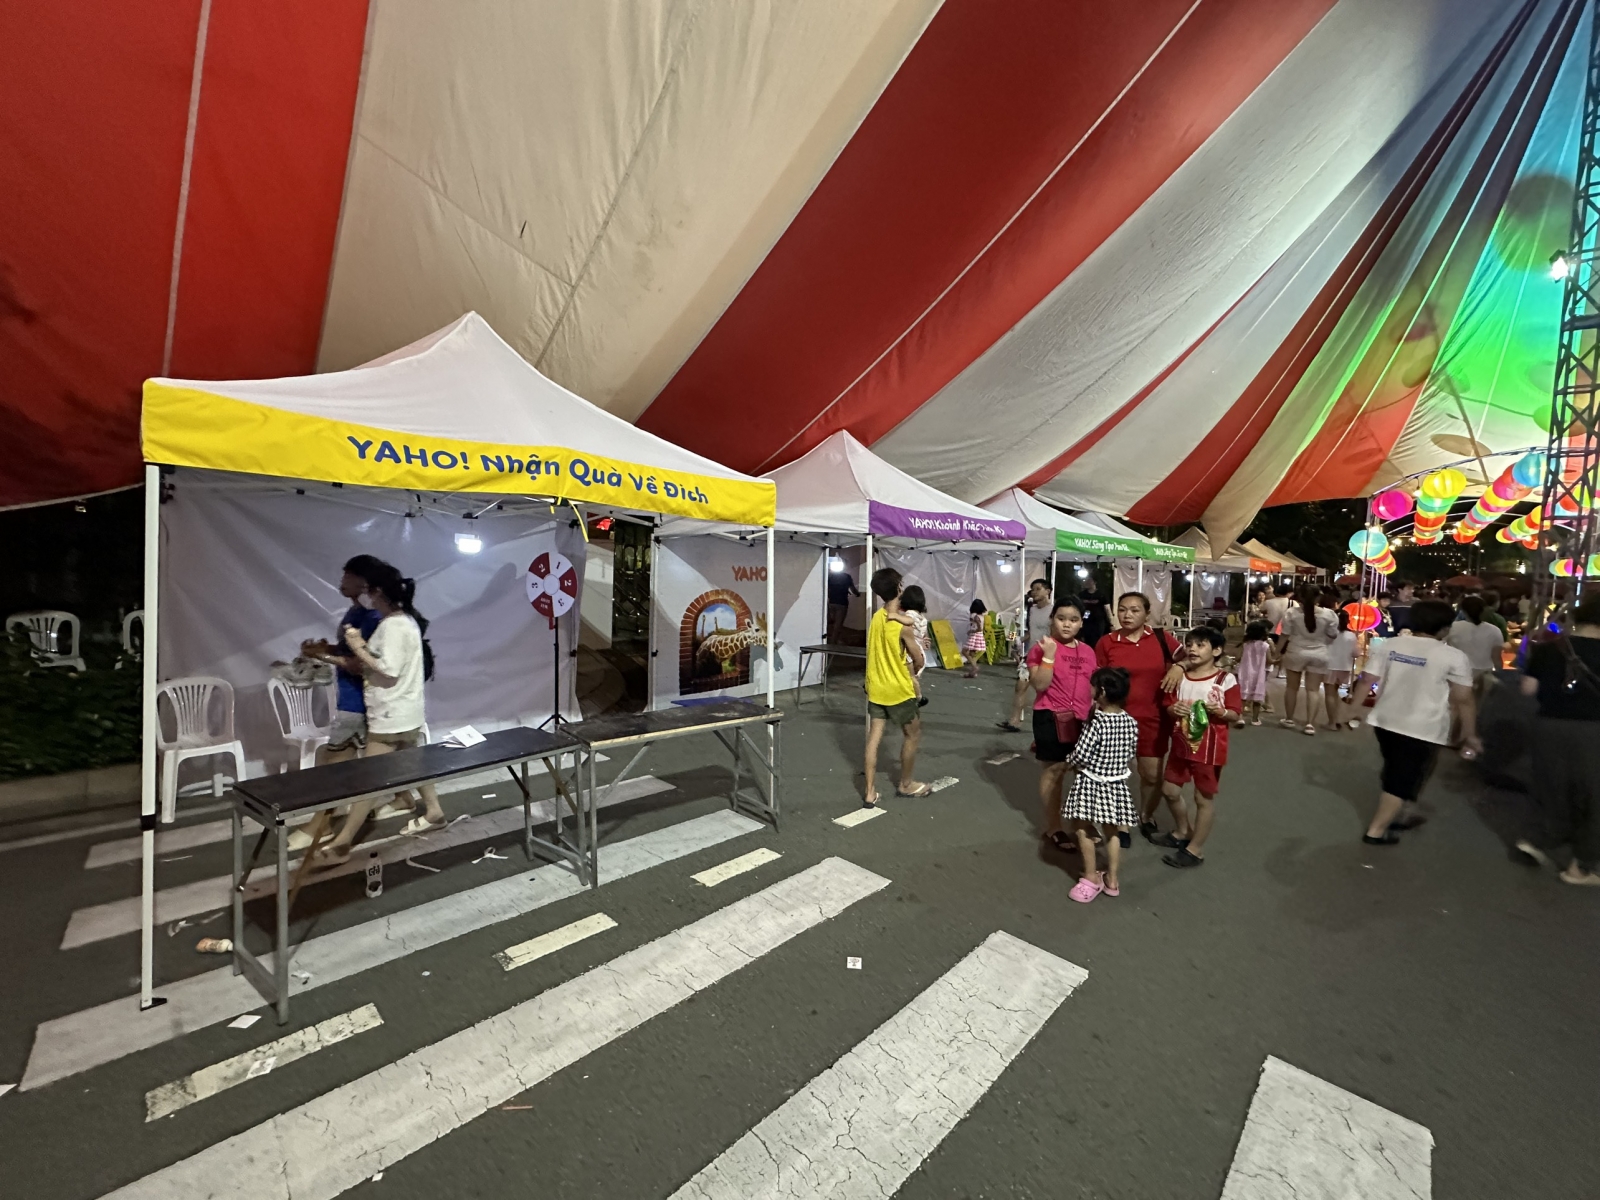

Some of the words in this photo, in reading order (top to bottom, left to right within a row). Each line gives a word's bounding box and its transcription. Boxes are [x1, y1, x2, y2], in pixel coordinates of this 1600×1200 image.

[347, 435, 470, 470] YAHO!
[480, 453, 560, 481] Nhận
[569, 458, 622, 487] Quà
[628, 472, 658, 495] Về
[538, 564, 546, 572] 2
